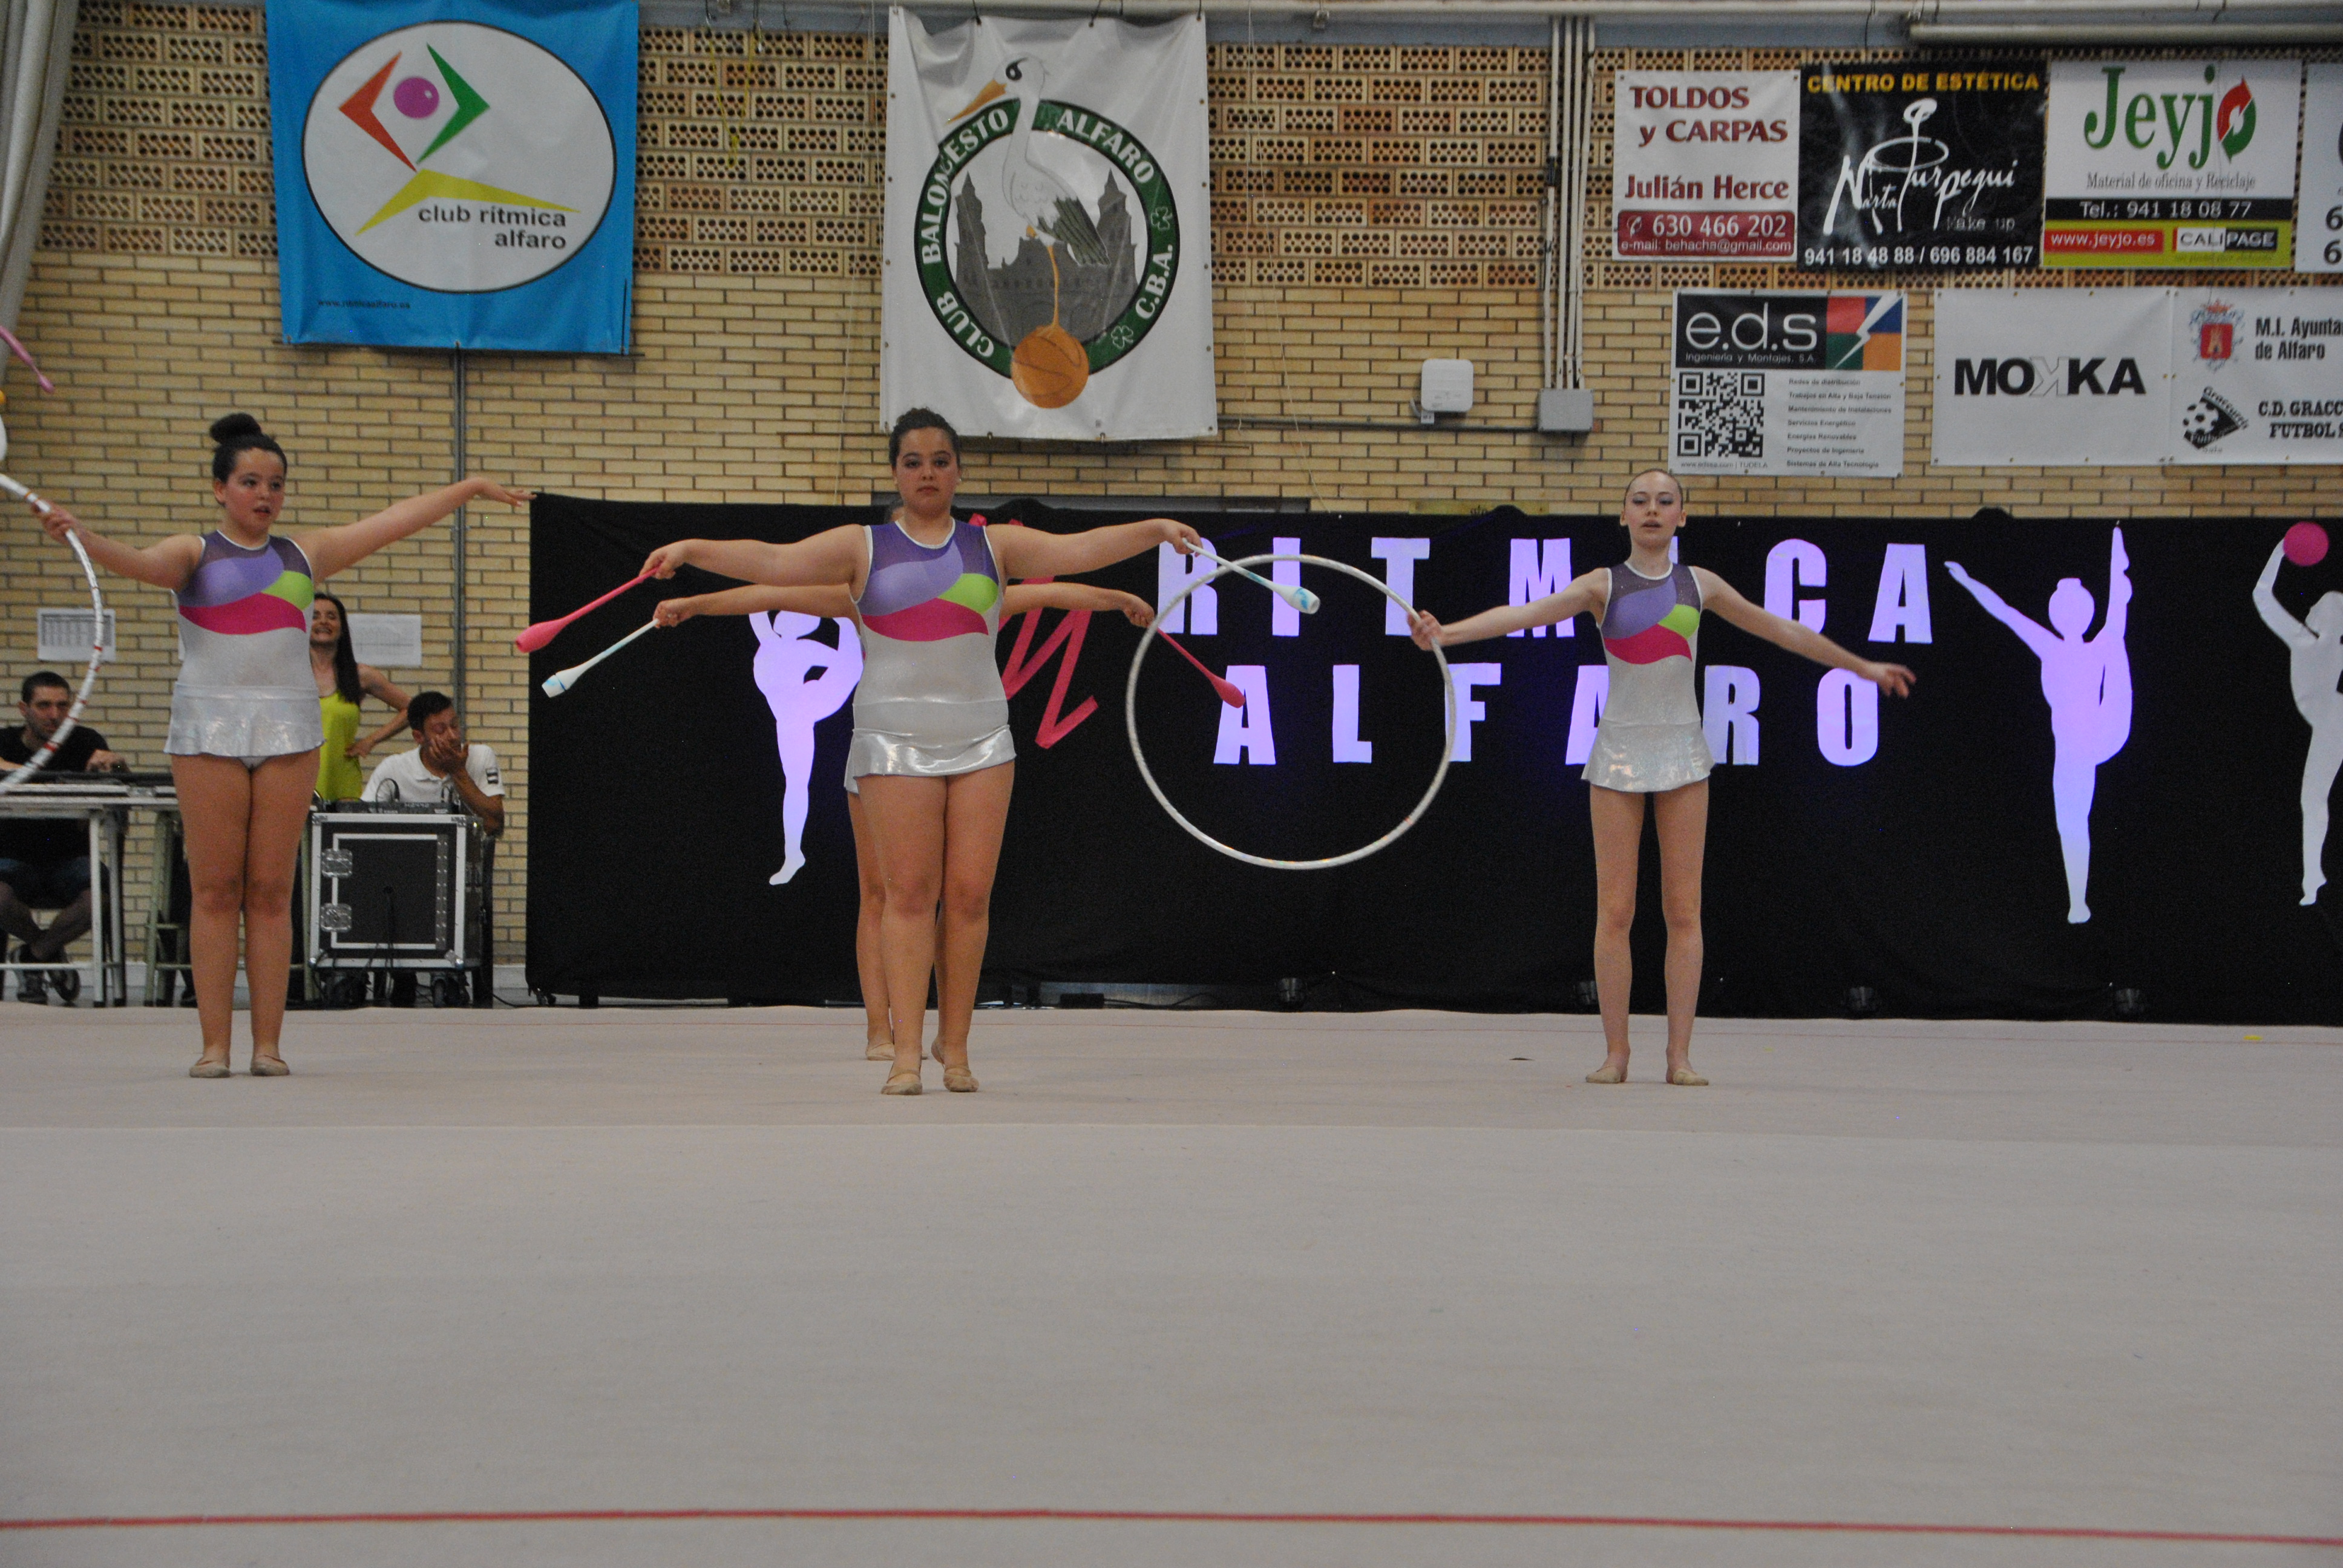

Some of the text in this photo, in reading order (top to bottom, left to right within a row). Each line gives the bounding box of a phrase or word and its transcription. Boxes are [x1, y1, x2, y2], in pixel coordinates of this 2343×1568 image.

[1807, 68, 2039, 94] CENTRO DE ESTÉTICA
[1629, 86, 1750, 109] TOLDOS
[2084, 64, 2256, 170] Jeyjo
[1638, 119, 1789, 148] y CARPAS
[1057, 108, 1155, 183] ALFARO
[921, 108, 1009, 264] BALONCESTO
[1624, 174, 1789, 200] Julián Herce
[2086, 172, 2256, 192] Material de oficina y Reciclaje
[418, 205, 470, 222] club
[2079, 200, 2252, 219] Tel.: 941 18 08 77
[2325, 206, 2343, 231] 6
[1653, 214, 1787, 237] 630 466 202
[494, 229, 566, 249] alfaro
[1665, 239, 1792, 254] behacha@gmail.com
[2050, 230, 2155, 249] www.jeyjo.es
[1804, 246, 2034, 266] 941 18 48 88 / 696 884 167
[2323, 240, 2342, 264] 6
[1135, 244, 1173, 319] C.B.A.
[936, 290, 995, 358] CLUB
[1686, 302, 1817, 351] e.d.s
[2255, 316, 2343, 339] M.I. Ayunta
[1737, 354, 1743, 363] y
[2255, 340, 2325, 360] de Alfaro
[2258, 400, 2286, 416] C.D.
[2269, 422, 2336, 439] FUTBOL
[1158, 535, 1932, 644] RITMCA
